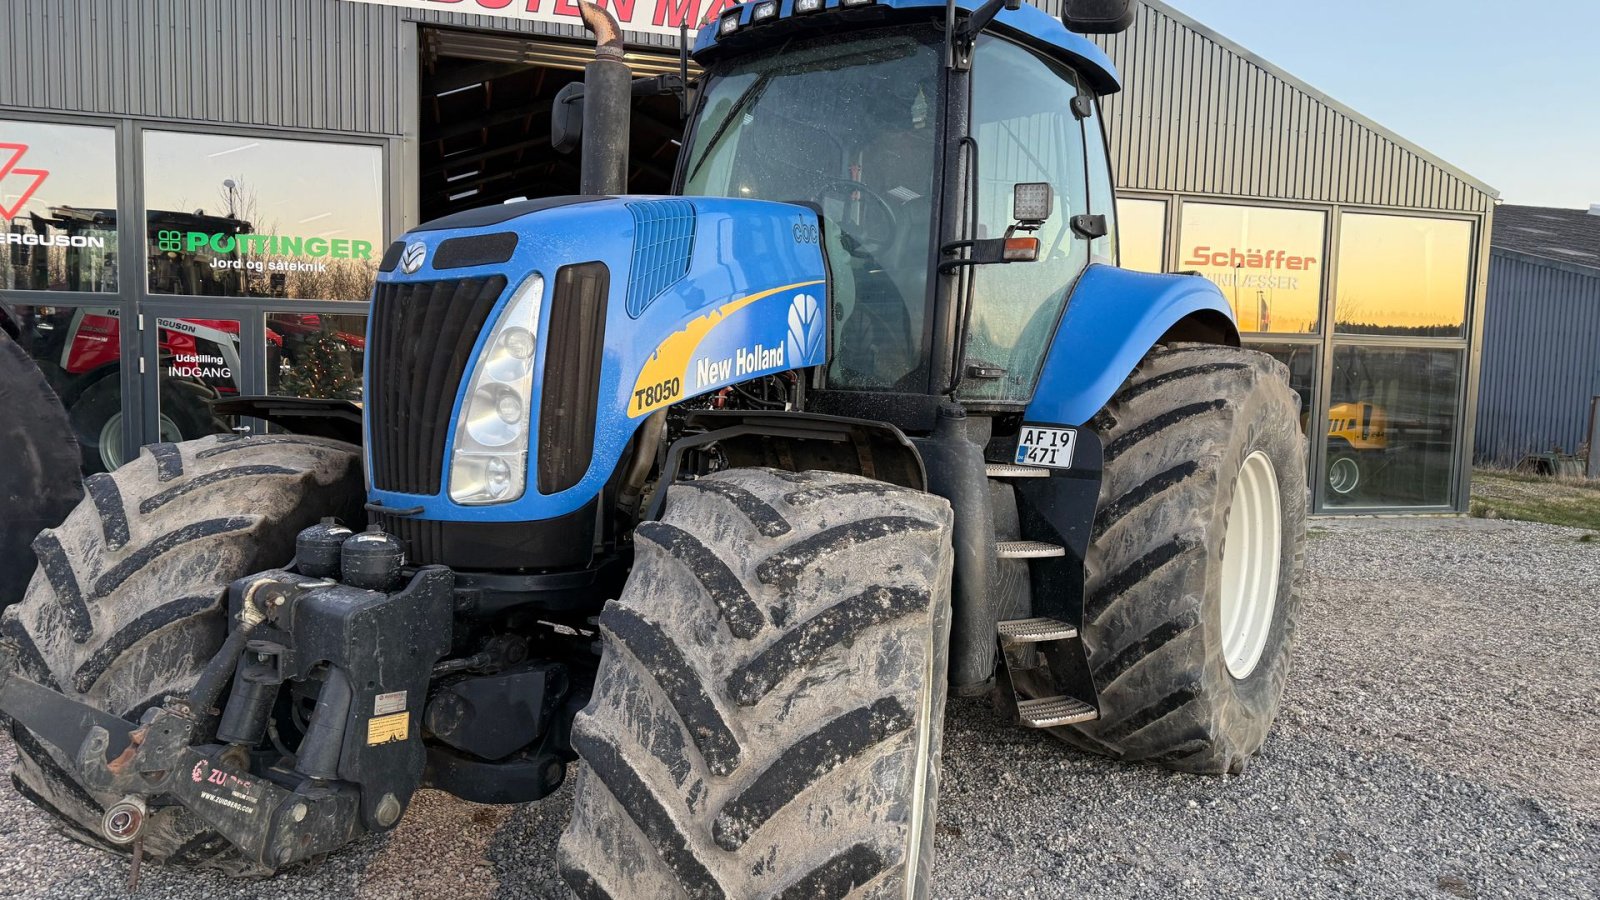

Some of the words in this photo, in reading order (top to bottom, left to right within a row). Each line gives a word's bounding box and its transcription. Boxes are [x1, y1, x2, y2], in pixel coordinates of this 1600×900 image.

[209, 257, 241, 269] Jord
[246, 260, 264, 273] og
[268, 259, 326, 273] såteknik
[1184, 245, 1317, 271] Schäffer
[175, 354, 224, 365] Udstilling
[696, 358, 736, 388] New
[735, 340, 784, 377] Holland
[168, 366, 231, 378] INDGANG
[635, 377, 680, 410] T8050
[1024, 430, 1047, 446] AF
[1049, 432, 1070, 447] 19
[1028, 447, 1057, 464] 471
